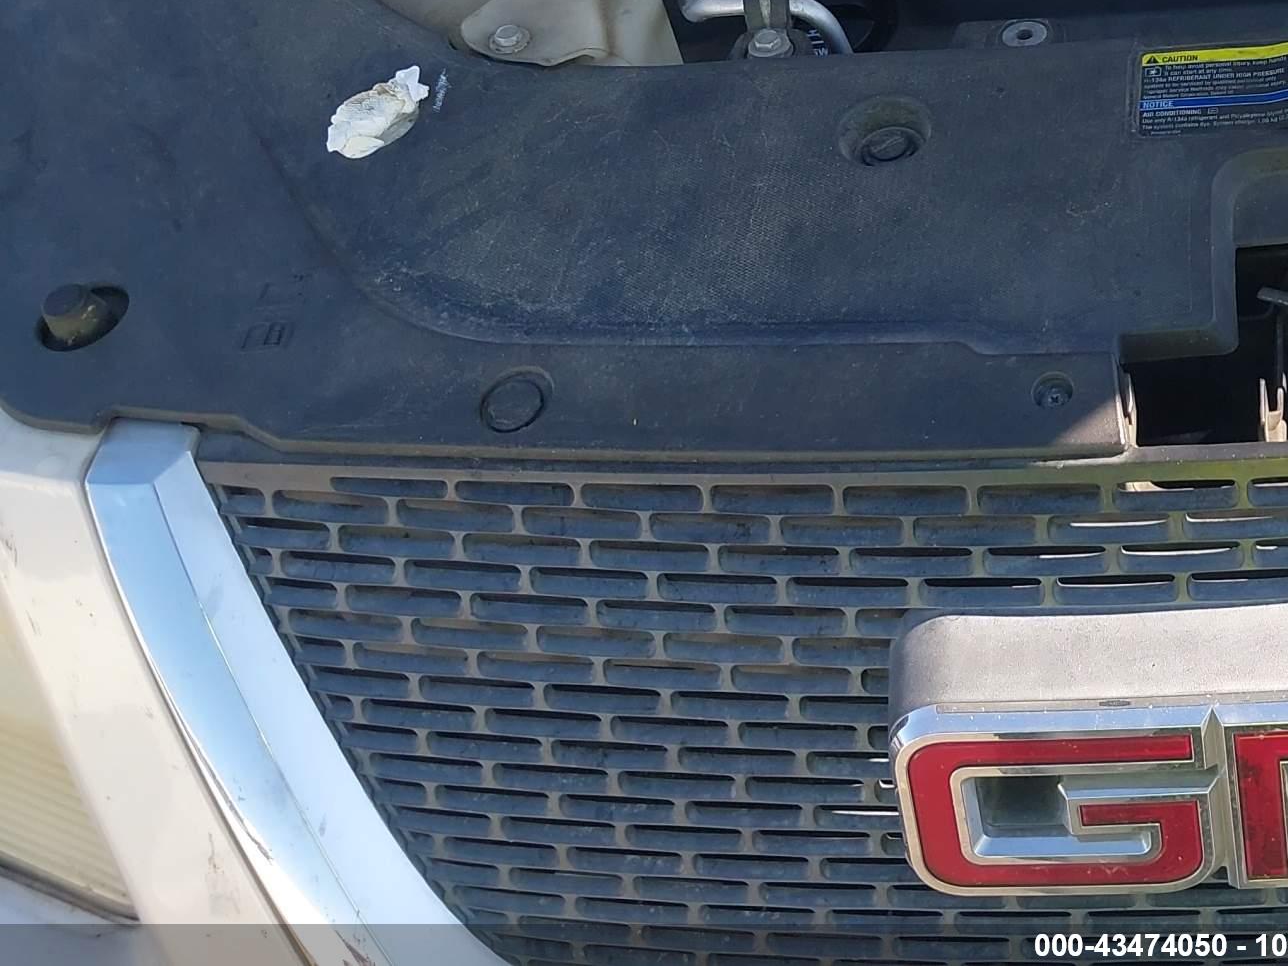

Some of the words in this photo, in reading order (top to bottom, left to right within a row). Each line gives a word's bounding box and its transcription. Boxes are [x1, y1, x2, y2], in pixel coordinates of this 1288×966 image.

[1162, 54, 1199, 63] CAUTION
[1212, 72, 1235, 80] UNDER
[1252, 67, 1285, 77] PRESSURE
[1143, 100, 1175, 108] NOTICE
